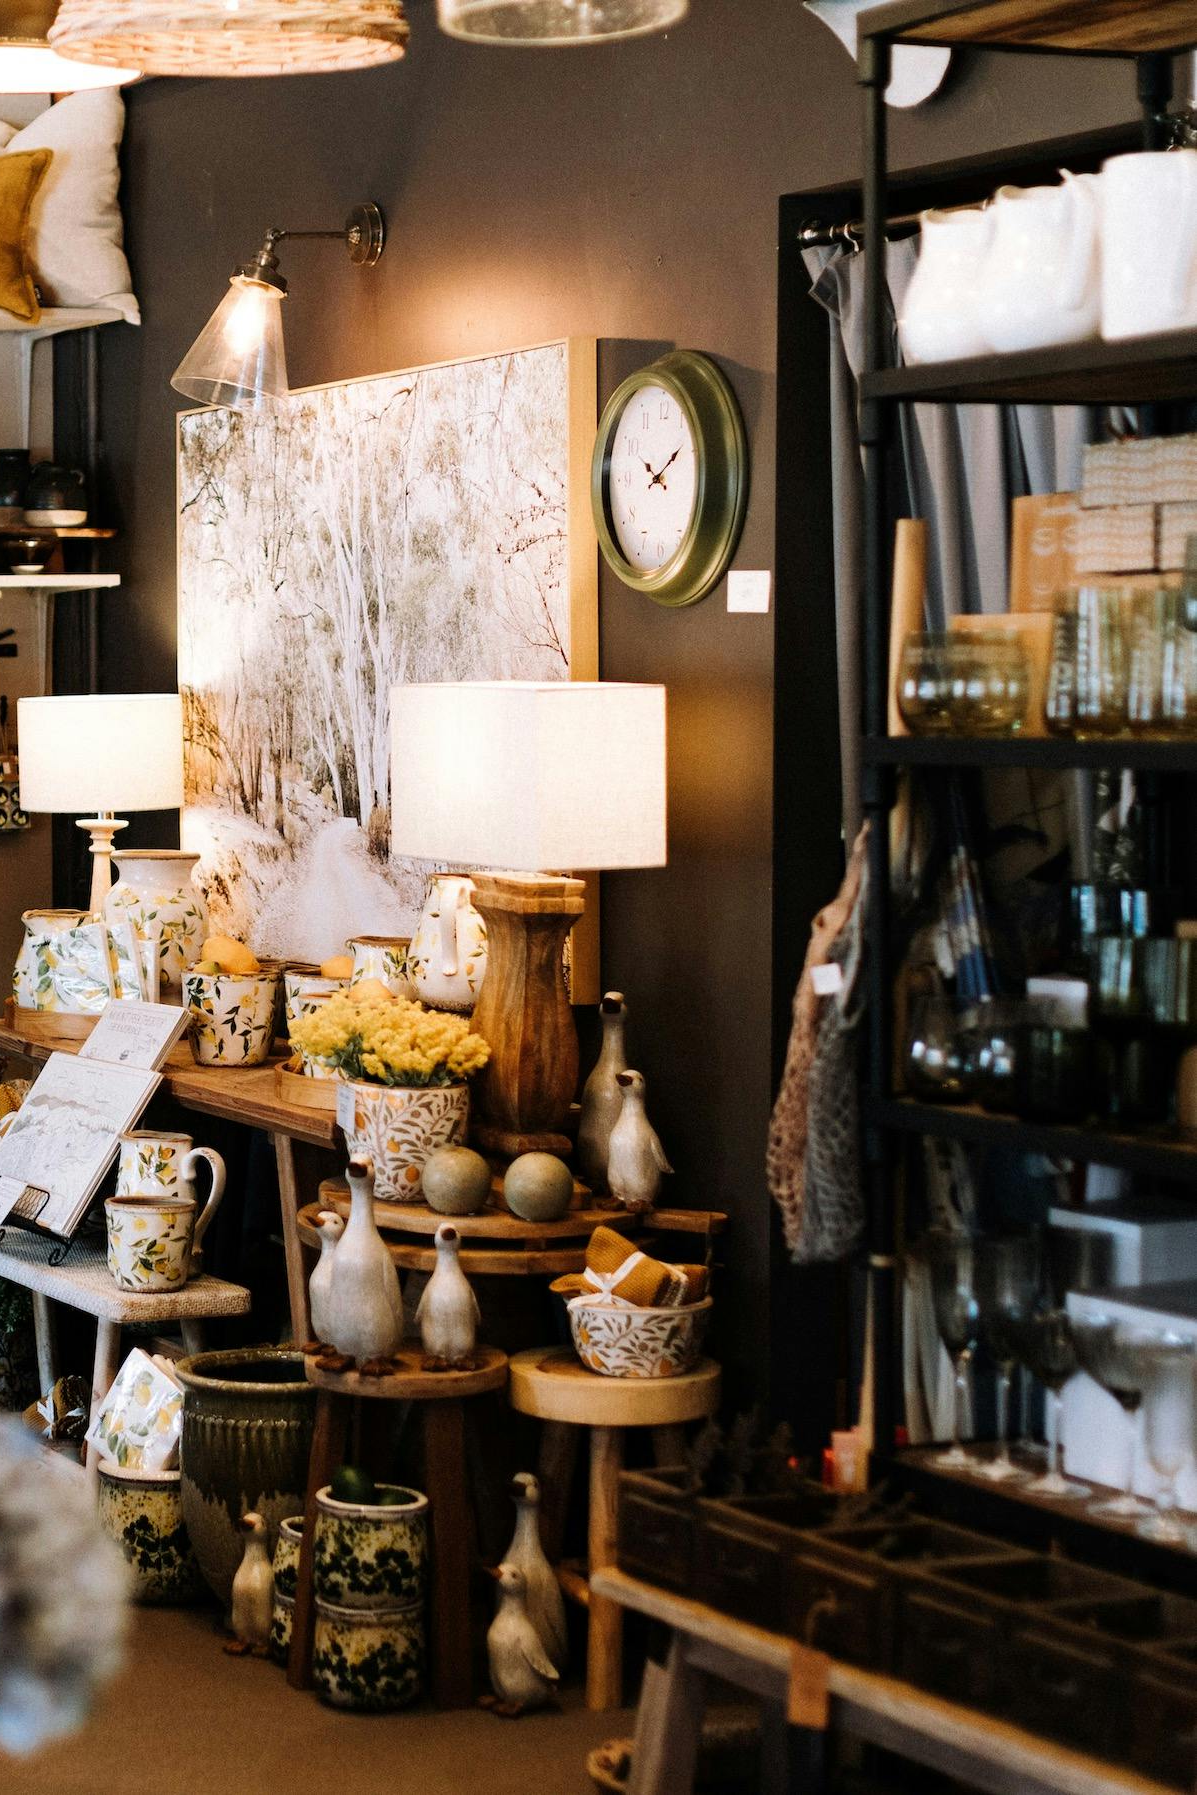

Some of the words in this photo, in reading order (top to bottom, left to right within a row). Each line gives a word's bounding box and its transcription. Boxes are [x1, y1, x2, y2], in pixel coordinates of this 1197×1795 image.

[659, 401, 670, 420] 12
[642, 412, 650, 430] 11
[627, 437, 639, 457] 10
[623, 475, 632, 488] 9
[628, 504, 637, 524] 8
